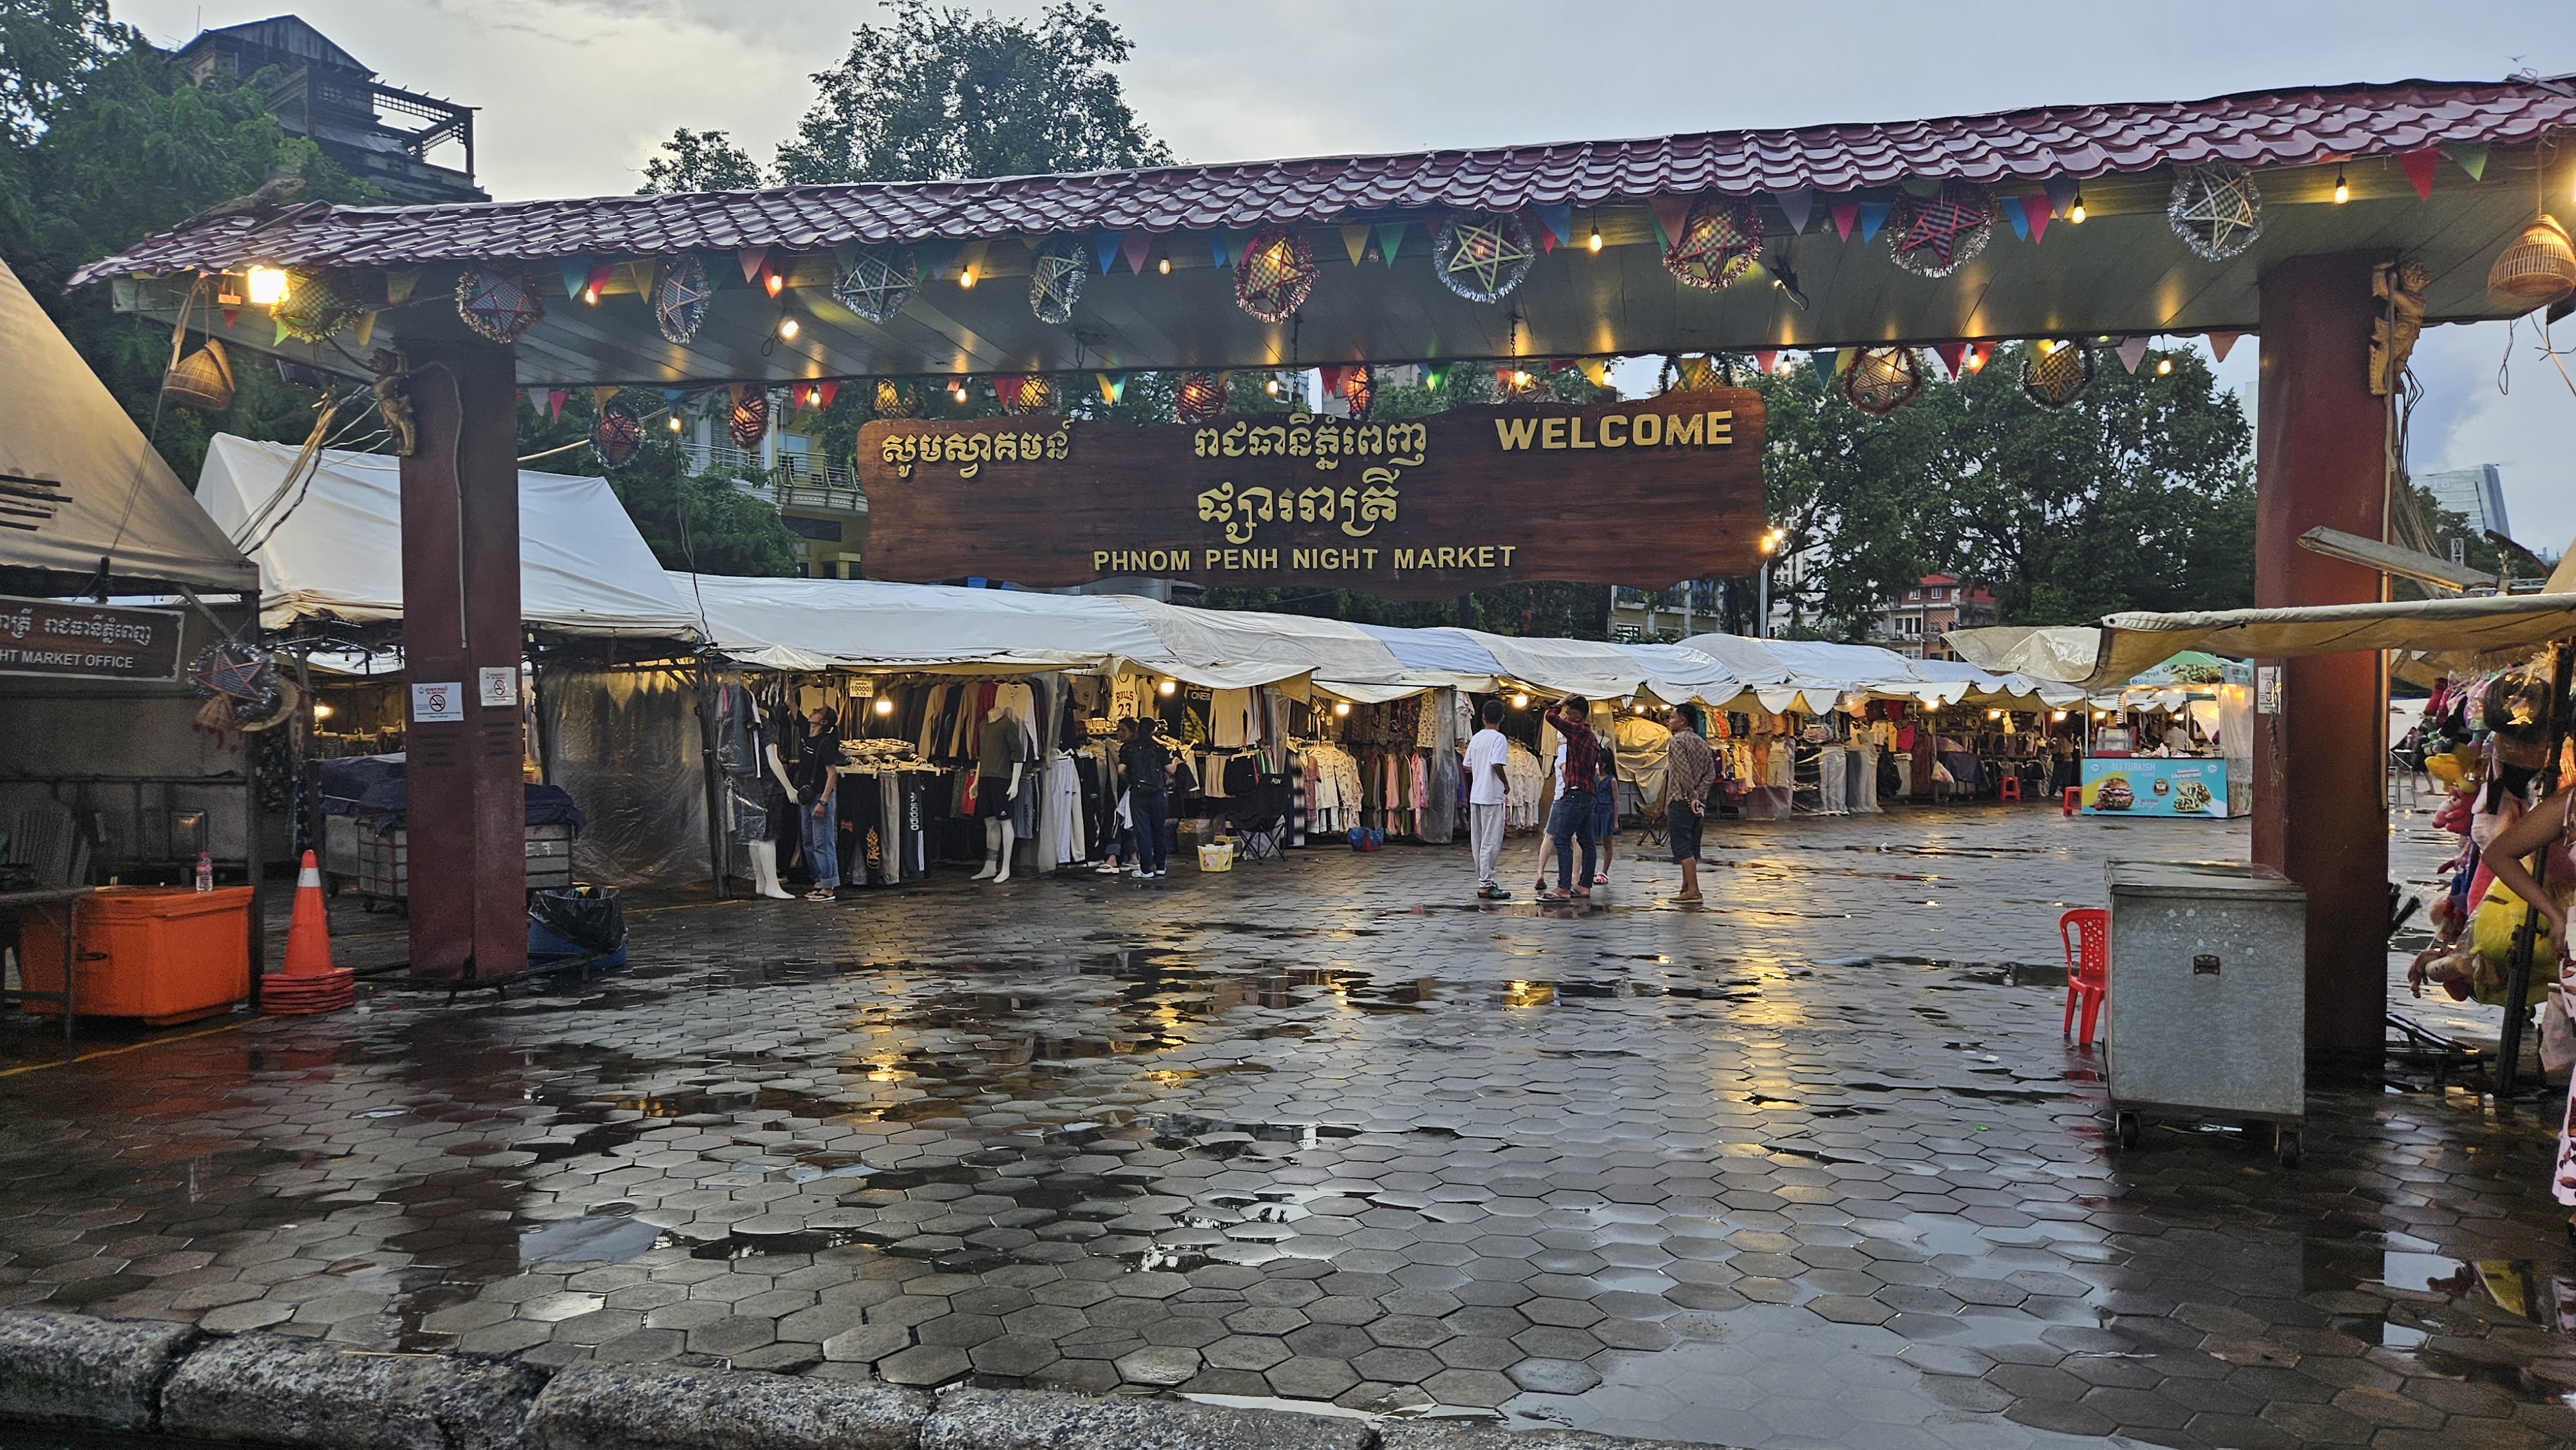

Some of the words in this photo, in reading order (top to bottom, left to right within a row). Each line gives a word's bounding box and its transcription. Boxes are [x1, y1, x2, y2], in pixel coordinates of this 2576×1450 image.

[1195, 413, 1427, 471] រាជធានីភ្នំពេញ
[1495, 410, 1733, 451] WELCOME
[881, 419, 1070, 478] សូមស្វាគមន៍
[1197, 467, 1401, 544] ផ្សាររាត្រី
[1094, 550, 1191, 572] PHNOM
[1206, 548, 1278, 570] PENH
[1293, 547, 1379, 570] NIGHT
[1393, 545, 1517, 569] MARKET
[44, 614, 151, 646] រាជធានីភ្នំពេញ
[21, 650, 82, 666] MARKET
[85, 654, 134, 668] OFFICE
[1115, 691, 1134, 702] BULLS
[1117, 702, 1132, 717] 23
[2124, 762, 2155, 771] TURKISH
[909, 802, 919, 831] adidas
